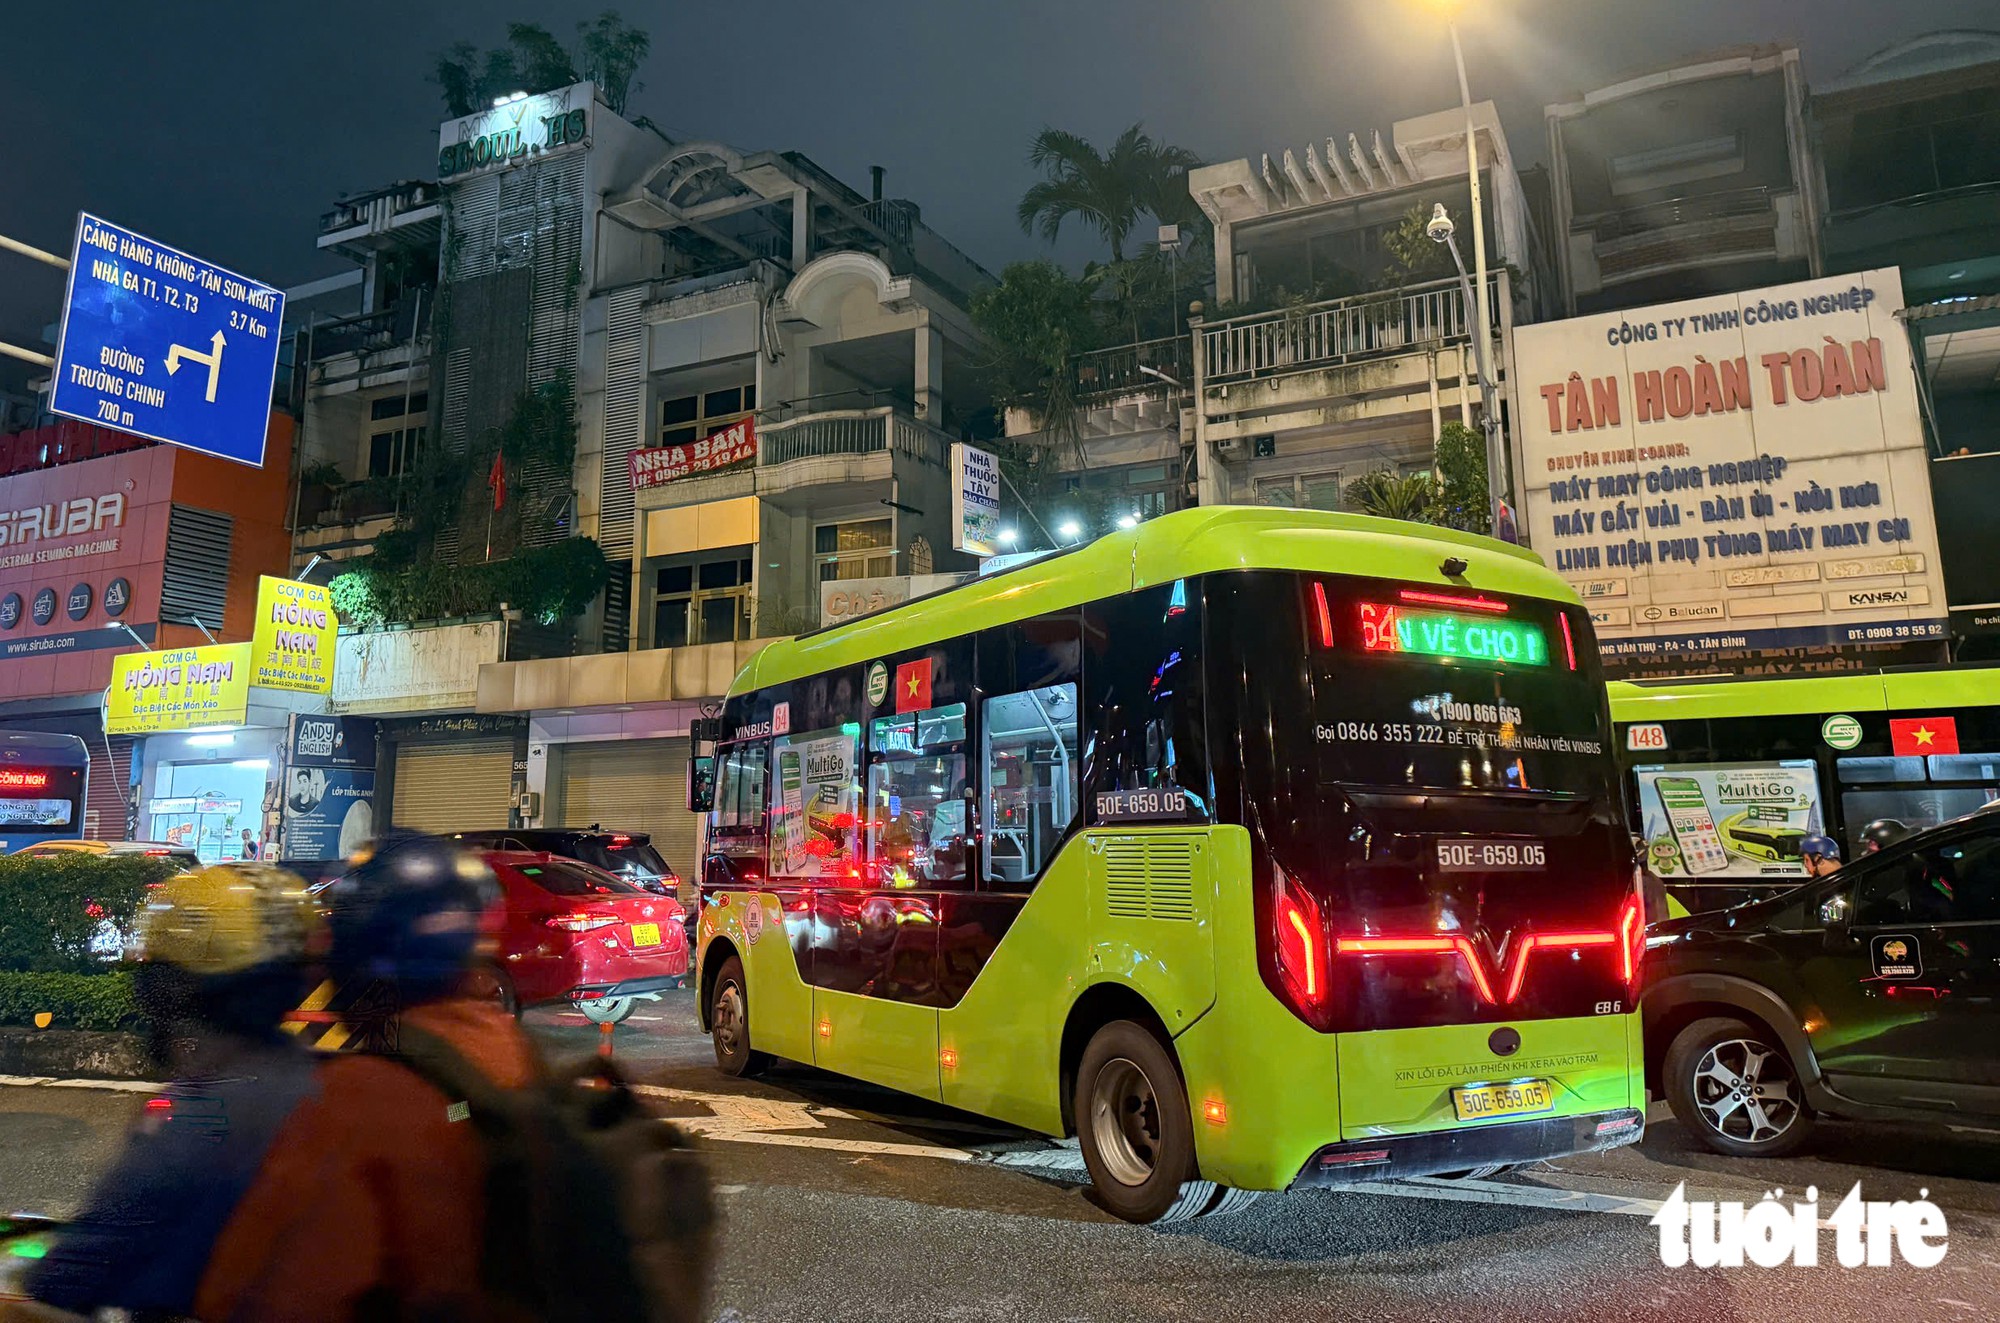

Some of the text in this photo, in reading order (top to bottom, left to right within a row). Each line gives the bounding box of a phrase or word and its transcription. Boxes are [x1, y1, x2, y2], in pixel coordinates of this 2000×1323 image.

[83, 222, 117, 252] CẢNG
[120, 236, 153, 266] HÀNG
[155, 252, 196, 282] KHÔNG
[223, 279, 246, 302] SƠN
[92, 259, 199, 313] NHÀ GA T1, T2, T3
[230, 310, 267, 338] 3.7 Km
[1607, 286, 1875, 346] CÔNG TY TNHH CÔNG NGHIỆP
[100, 345, 145, 376] ĐƯỜNG
[70, 359, 165, 408] TRƯỜNG CHINH
[1540, 336, 1887, 432] TÂN HOÀN TOÀN
[98, 399, 134, 426] 700 m
[969, 451, 991, 469] NHÀ
[1547, 451, 1599, 472] CHUYÊN
[1602, 448, 1636, 465] KINH
[963, 464, 998, 485] THUỐC
[1550, 453, 1788, 503] MÁY MAY CÔNG NGHIỆP
[970, 480, 990, 496] TÂY
[1553, 509, 1596, 536] MÁY
[1645, 499, 1681, 528] VẢI
[1700, 494, 1745, 523] BÀN
[1794, 480, 1834, 513] NỒI
[36, 546, 74, 563] SEWING
[74, 538, 120, 558] MACHINE
[1556, 546, 1600, 571] LINH
[1606, 538, 1652, 571] KIỆN
[1658, 537, 1700, 566] PHỤ
[1703, 530, 1763, 558] TÙNG
[1766, 523, 1815, 552] MÁY
[1821, 521, 1870, 548] MAY
[277, 584, 304, 599] CƠM
[1849, 591, 1908, 603] KANSAI
[272, 598, 327, 630] HỒNG
[1360, 603, 1397, 650] 64
[1848, 624, 1943, 640] ĐT: 0908 38 55 92
[7, 636, 75, 653] www.siruba.com
[275, 630, 318, 655] NAM
[1638, 642, 1656, 655] THỤ
[1664, 641, 1679, 651] P.4
[1687, 639, 1698, 650] Q.
[1699, 638, 1720, 649] TÂN
[1721, 636, 1746, 647] BÌNH
[162, 650, 198, 664] CƠM GÀ
[125, 661, 181, 692] HỒNG
[187, 661, 233, 685] NAM
[183, 701, 200, 710] Món
[1440, 701, 1522, 725] 1900 866 663
[735, 721, 771, 739] VINBUS
[774, 706, 787, 730] 64
[300, 722, 334, 742] ANDY
[1316, 724, 1335, 743] Gọi
[1337, 722, 1378, 741] 0866
[1383, 723, 1412, 742] 355
[1417, 725, 1444, 744] 222
[1523, 735, 1550, 750] NHÂN
[1551, 737, 1571, 752] VIÊN
[1571, 740, 1602, 754] VINBUS
[1630, 725, 1663, 749] 148
[300, 742, 332, 754] ENGLISH
[807, 755, 844, 774] MultiGo
[25, 774, 46, 785] NGH
[332, 785, 343, 797] LỚP
[344, 784, 361, 797] TIẾNG
[1717, 783, 1794, 797] MultiGo
[1097, 792, 1185, 815] 50E-659.05
[1437, 844, 1546, 866] 50E-659.05
[1395, 1071, 1414, 1081] XIN
[1456, 1064, 1478, 1075] LÀM
[1512, 1061, 1528, 1071] KHI
[1530, 1060, 1541, 1069] XE
[1543, 1058, 1555, 1068] RA
[1462, 1086, 1544, 1114] 50E-659.05
